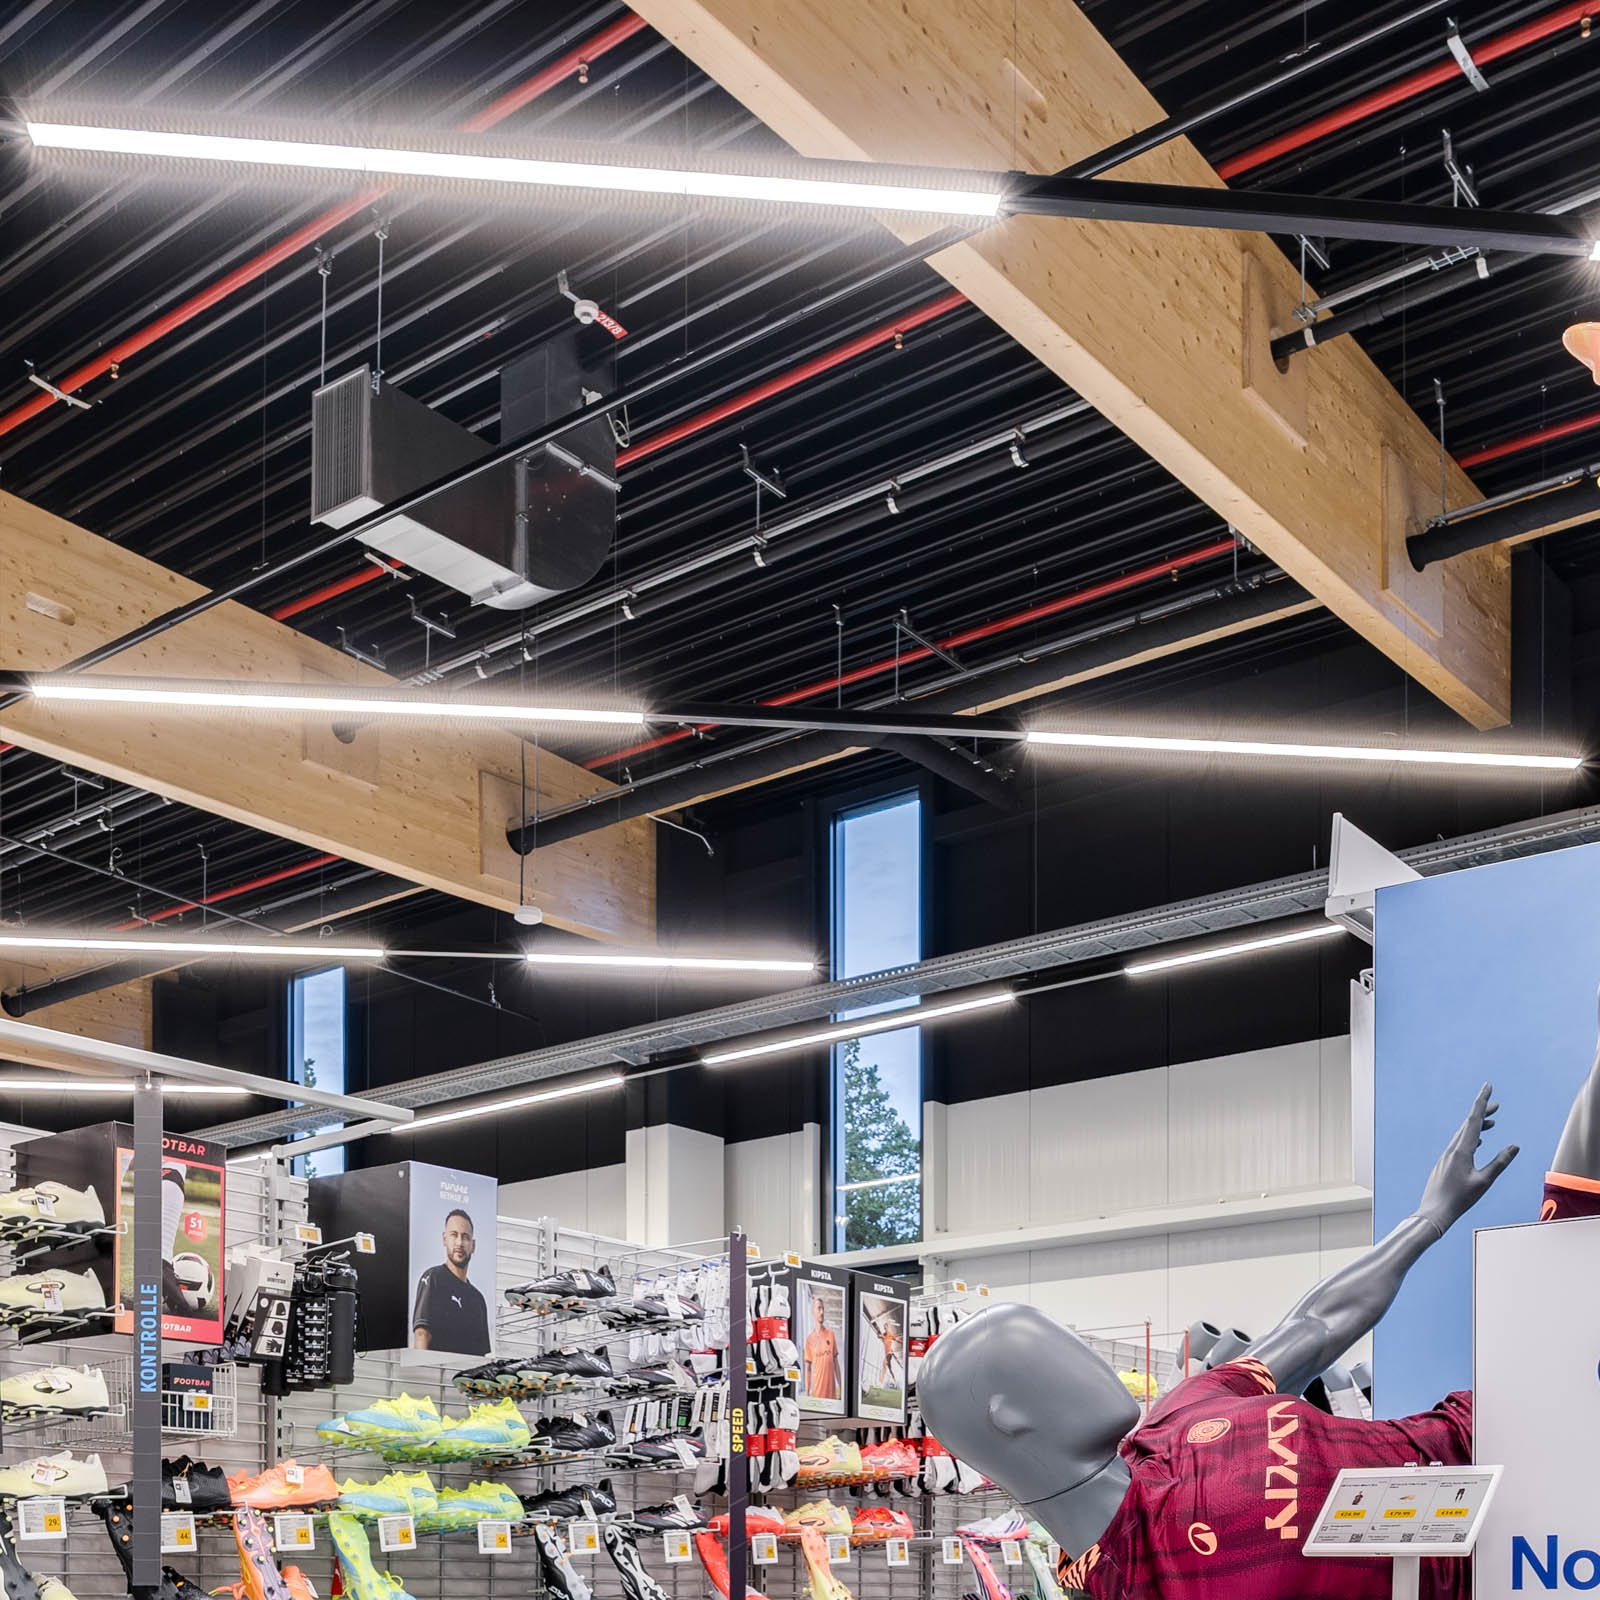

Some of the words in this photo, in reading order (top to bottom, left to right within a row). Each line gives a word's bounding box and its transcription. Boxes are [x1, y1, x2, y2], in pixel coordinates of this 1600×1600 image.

[161, 1137, 207, 1157] OTBAR
[810, 1269, 832, 1281] KIPSTA
[873, 1283, 895, 1295] KIPSTA
[140, 1283, 159, 1393] KONTROLLE
[173, 1376, 212, 1388] FOOTBAR
[732, 1407, 744, 1453] SPEED
[48, 1517, 58, 1527] 29
[180, 1532, 189, 1540] 44
